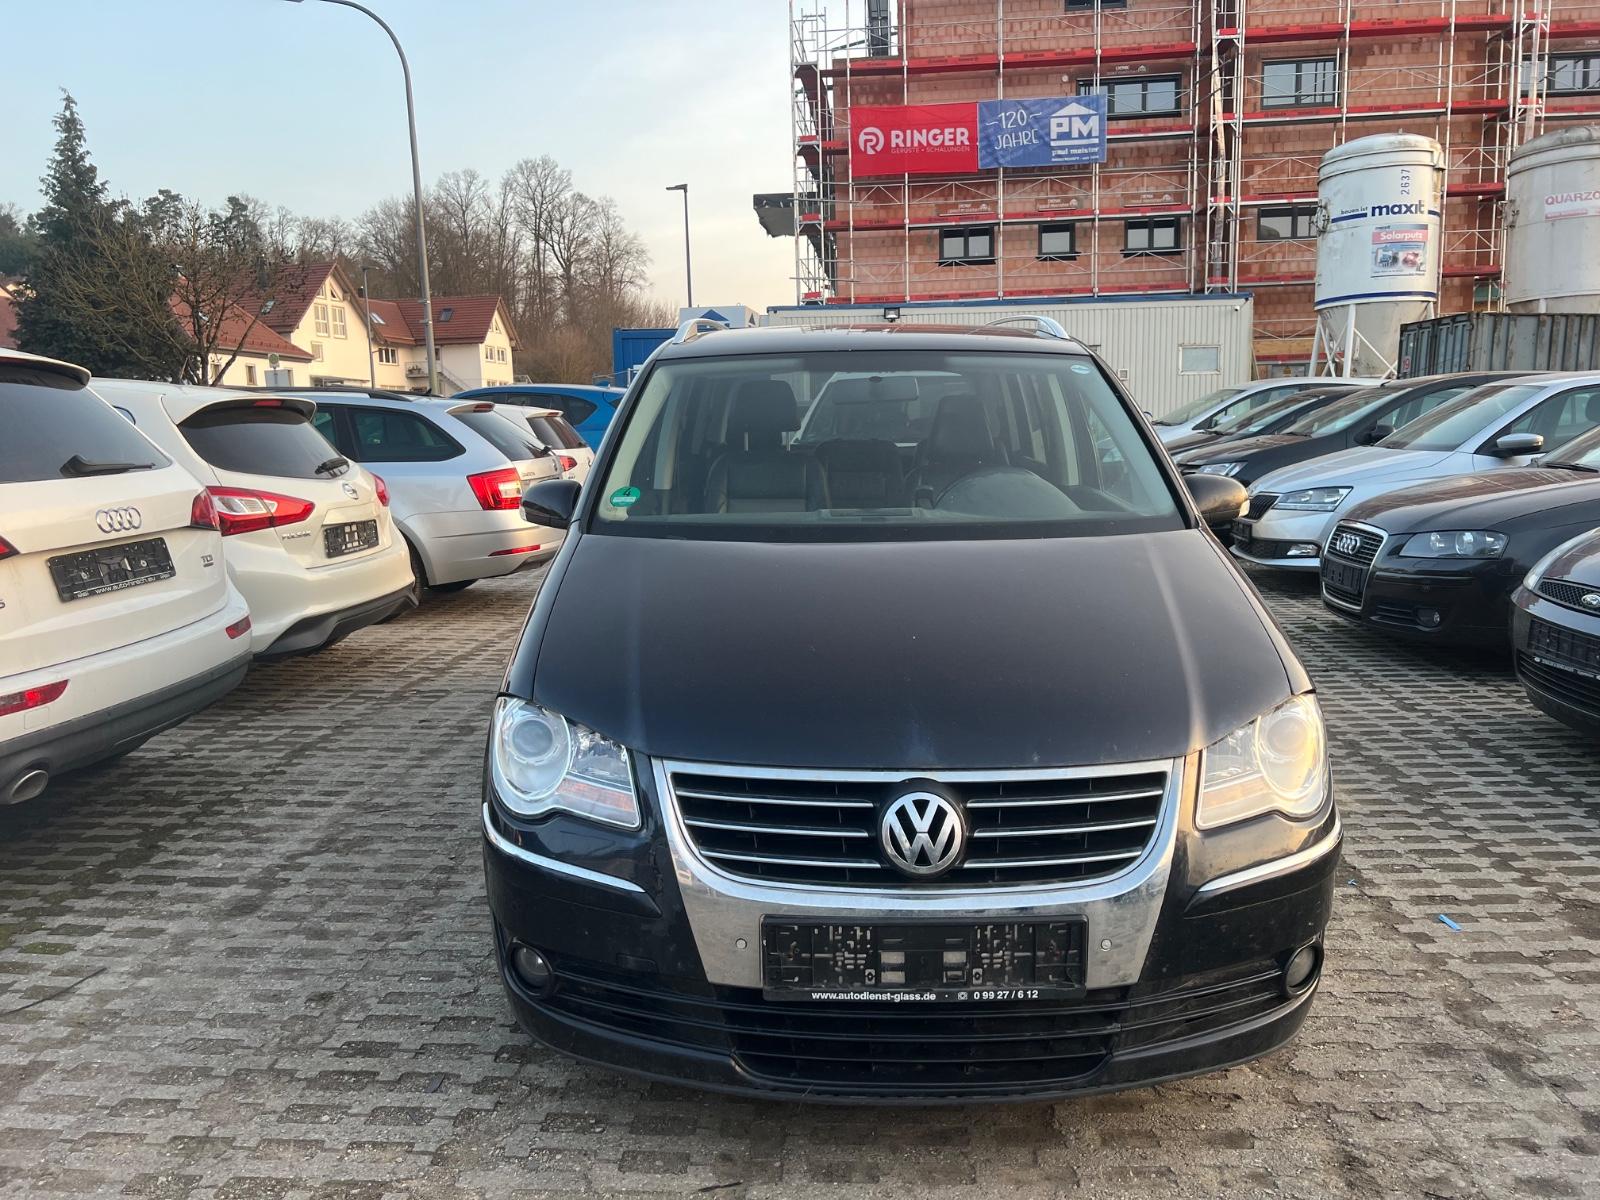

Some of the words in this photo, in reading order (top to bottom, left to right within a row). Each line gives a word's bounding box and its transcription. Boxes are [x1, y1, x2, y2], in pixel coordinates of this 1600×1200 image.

[998, 109, 1027, 129] 120
[1050, 115, 1099, 139] PM
[891, 128, 970, 148] RINGER
[995, 129, 1039, 150] JAHRE
[1400, 169, 1411, 195] 2637
[1371, 200, 1425, 217] maxit
[1380, 231, 1423, 241] Solarputz
[811, 991, 937, 1002] www.autodienst-glass.de
[982, 991, 995, 1000] 99
[997, 991, 1010, 1000] 27
[1017, 990, 1024, 999] 6
[1027, 990, 1039, 999] 12
